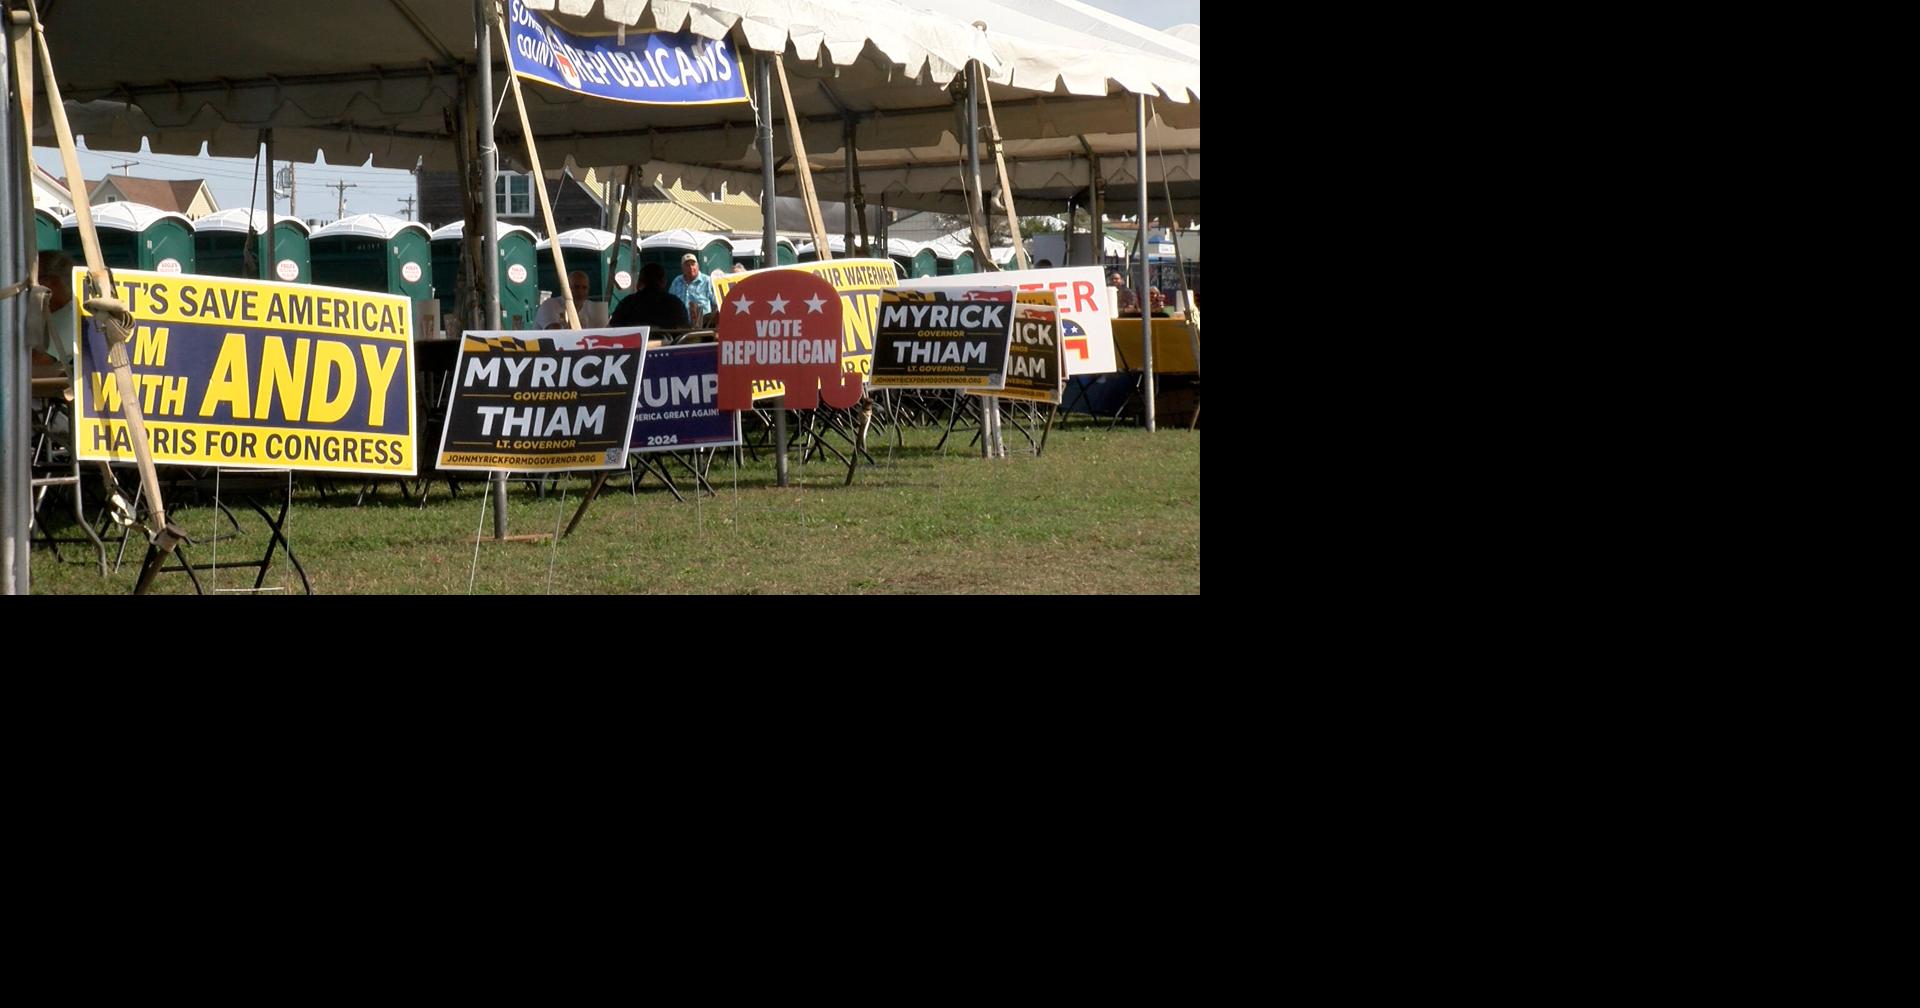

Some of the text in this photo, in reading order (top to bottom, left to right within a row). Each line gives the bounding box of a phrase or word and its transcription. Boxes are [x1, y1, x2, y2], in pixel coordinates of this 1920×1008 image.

[564, 40, 732, 87] REPUBLICANS
[179, 286, 259, 321] SAVE
[266, 293, 405, 335] AMERICA!
[883, 304, 1004, 328] MYRICK
[755, 319, 802, 338] VOTE
[721, 339, 837, 365] REPUBLICAN
[893, 341, 987, 364] THIAM
[199, 333, 403, 427] ANDY
[463, 353, 632, 388] MYRICK
[919, 365, 965, 373] GOVERNOR
[513, 391, 577, 401] GOVERNOR
[637, 373, 718, 408] UMP
[477, 405, 606, 437] THIAM
[663, 410, 689, 419] GREAT
[94, 424, 404, 466] HARIS FOR CONGRESS
[495, 439, 576, 449] LT. GOVERNOR
[647, 434, 678, 446] 2024
[447, 453, 596, 465] JOHNMYRICKFORMDGOVERNOR.ORG
